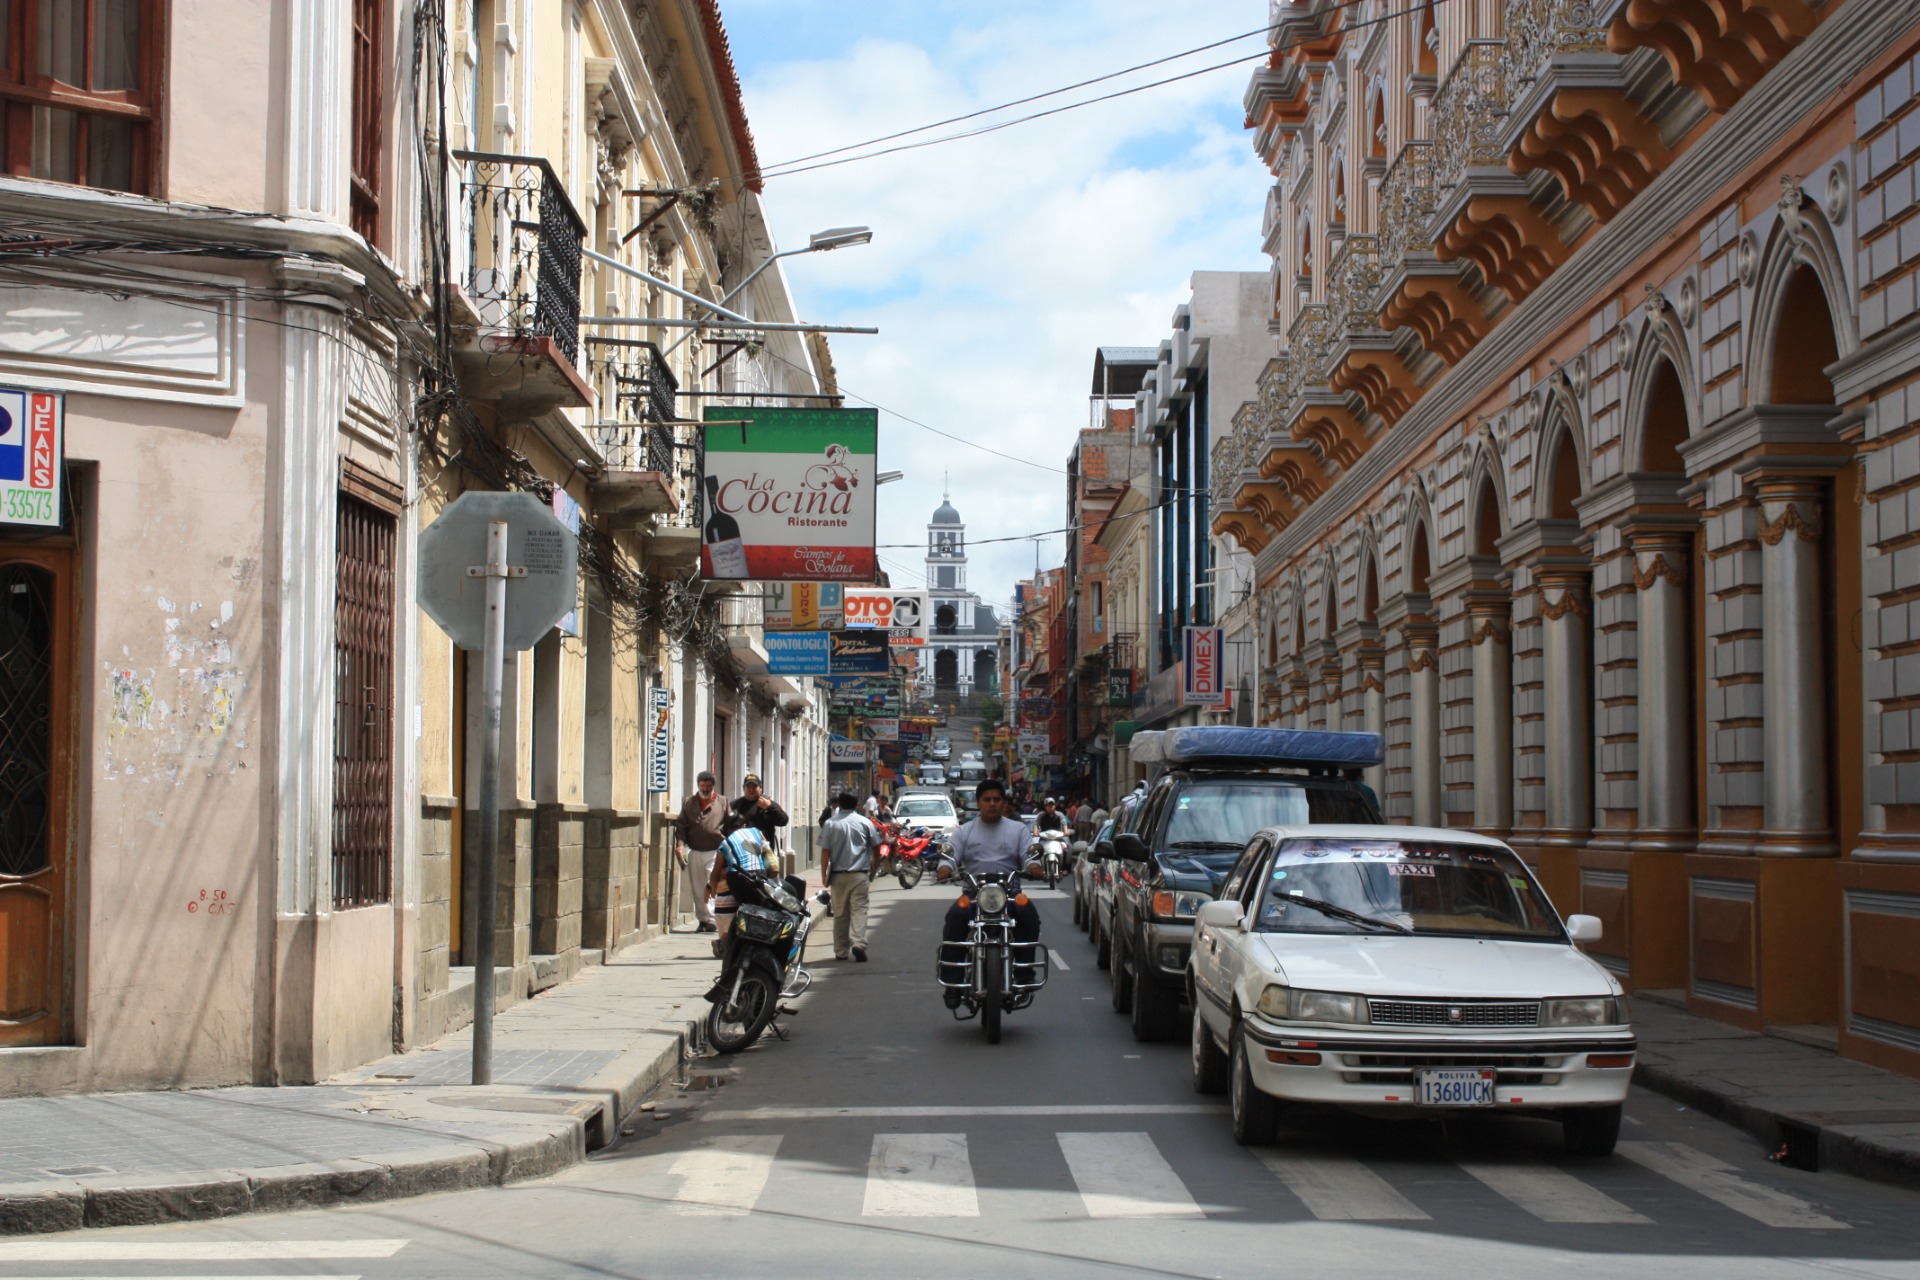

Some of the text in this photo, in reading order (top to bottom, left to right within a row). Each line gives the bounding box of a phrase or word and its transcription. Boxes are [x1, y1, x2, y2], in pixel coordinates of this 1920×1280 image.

[34, 396, 52, 487] JEANS
[747, 472, 775, 491] La
[0, 489, 53, 520] -33573
[716, 478, 853, 515] Cocina
[787, 517, 848, 528] Ristorante
[794, 546, 846, 565] Campos de
[805, 557, 855, 573] Solana
[765, 639, 828, 650] ODONTOLOGICA
[1196, 630, 1212, 692] DIMEX
[1111, 677, 1129, 685] BNB
[1111, 684, 1128, 699] 24
[655, 729, 668, 789] DIARIO
[843, 745, 865, 758] Entel
[1349, 847, 1451, 862] TOYOTA
[1390, 864, 1434, 875] TAXI
[1425, 1081, 1491, 1102] 1368UCK
